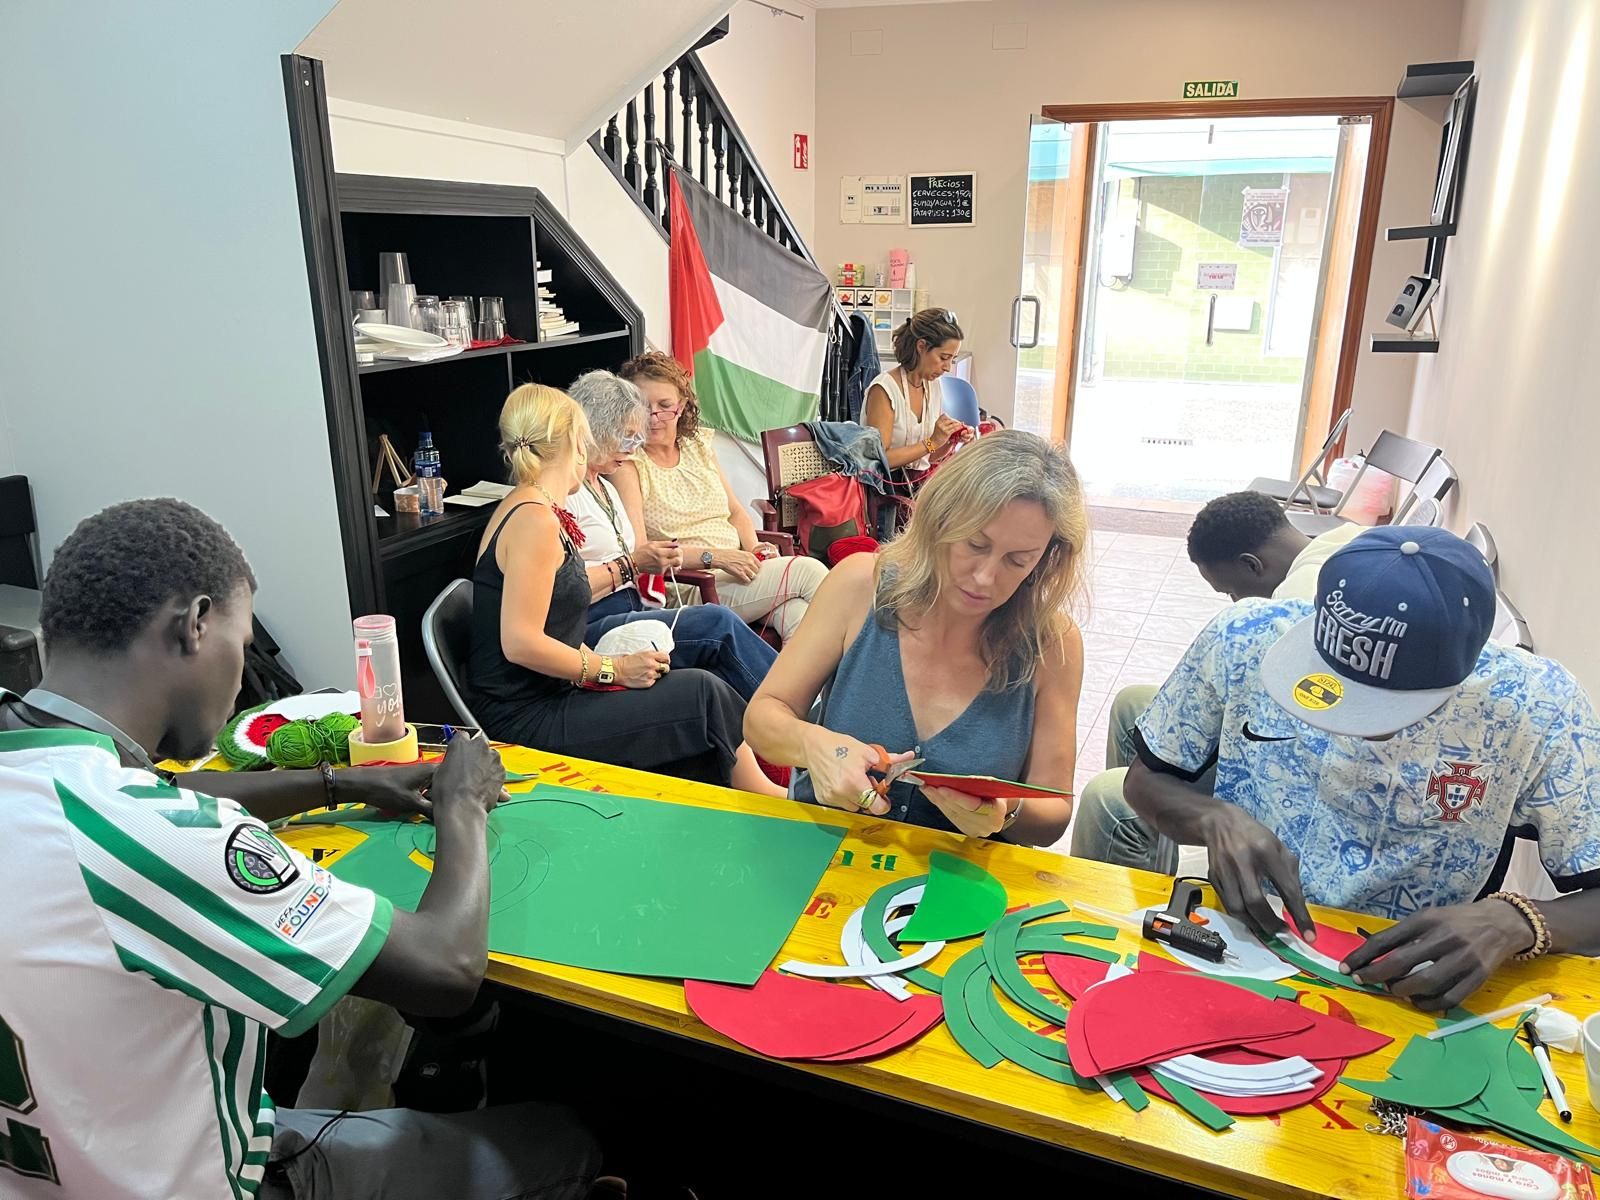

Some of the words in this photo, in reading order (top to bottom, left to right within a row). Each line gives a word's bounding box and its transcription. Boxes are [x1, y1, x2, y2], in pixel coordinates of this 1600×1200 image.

[1186, 82, 1235, 97] SALIDA
[1326, 590, 1382, 633] Sorry
[1317, 606, 1399, 680] FRESH
[275, 907, 294, 929] UEFA
